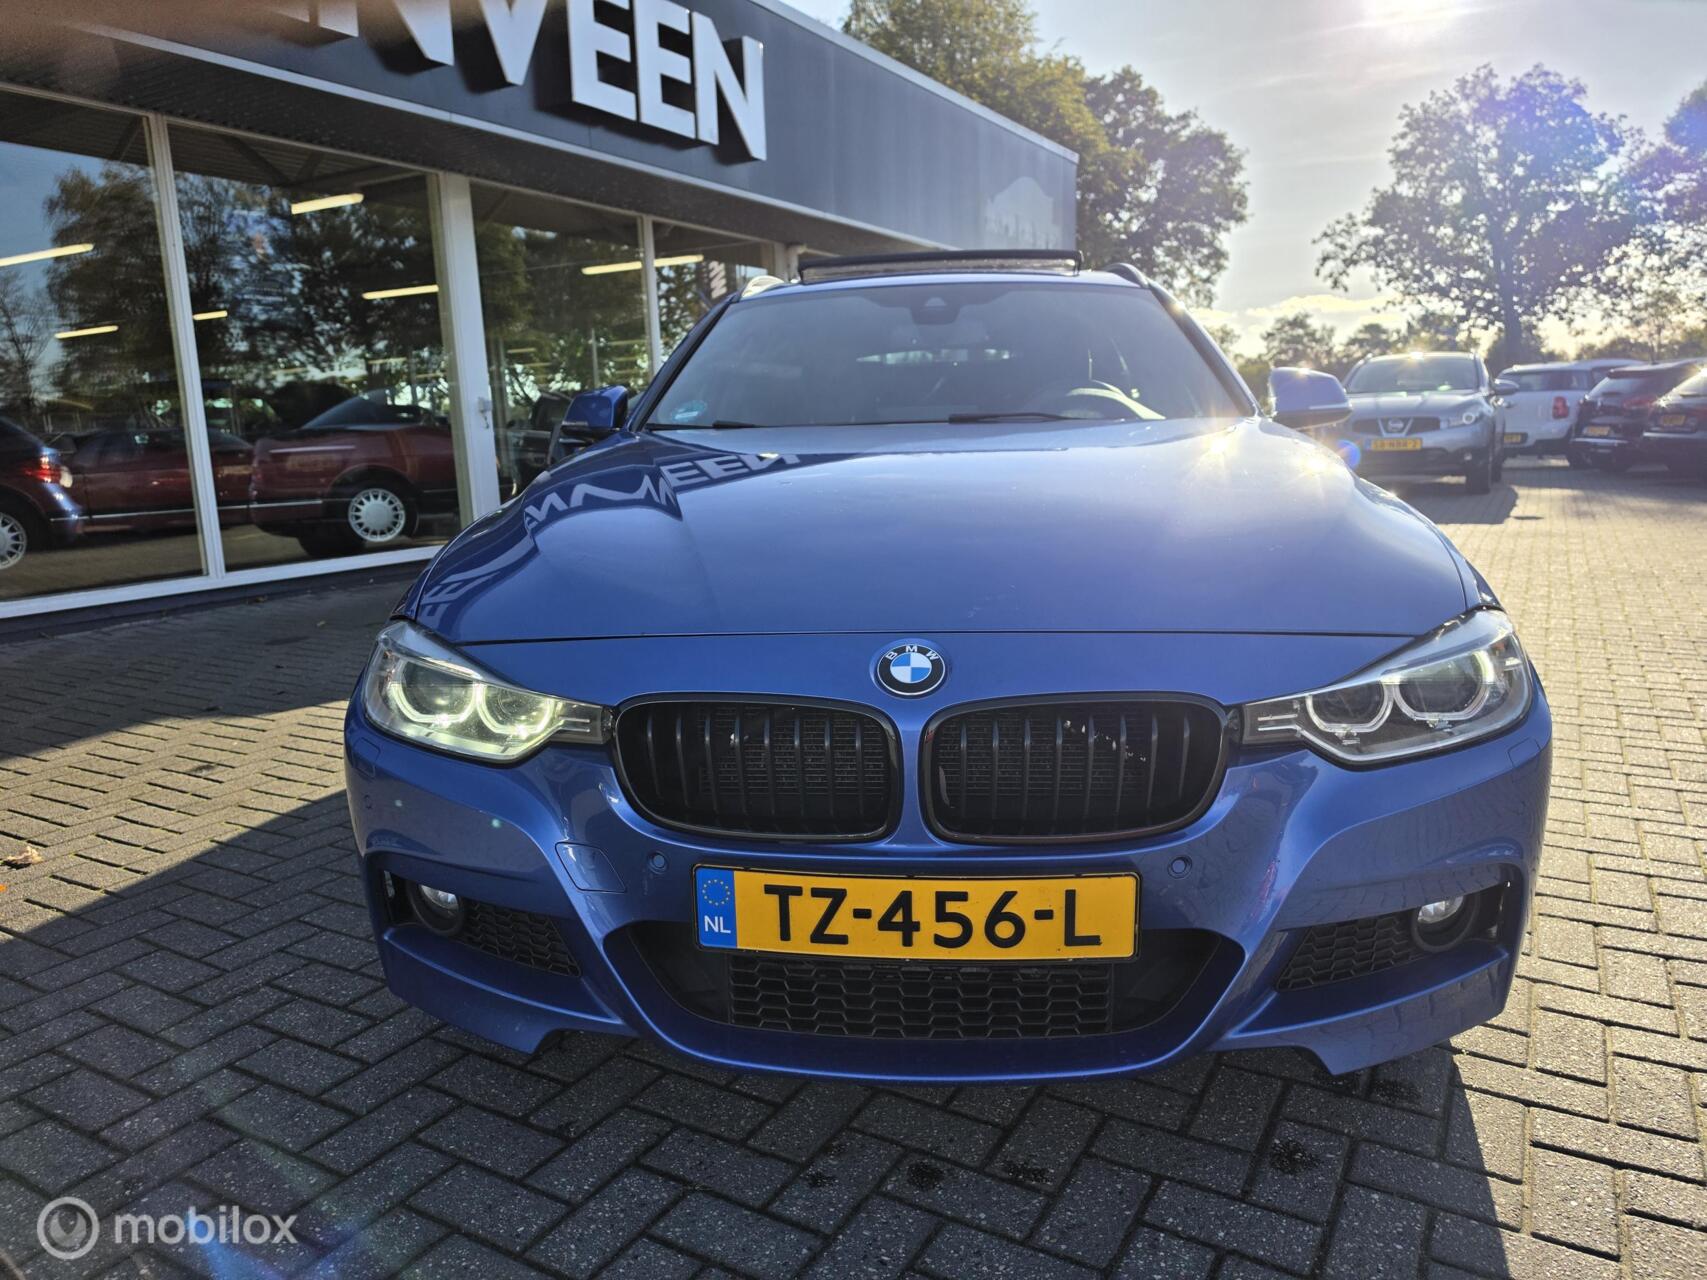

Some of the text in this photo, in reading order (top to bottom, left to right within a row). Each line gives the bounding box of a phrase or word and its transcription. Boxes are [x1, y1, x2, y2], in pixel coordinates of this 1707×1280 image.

[885, 645, 940, 661] BMW
[703, 884, 1103, 949] NL TZ-456-L
